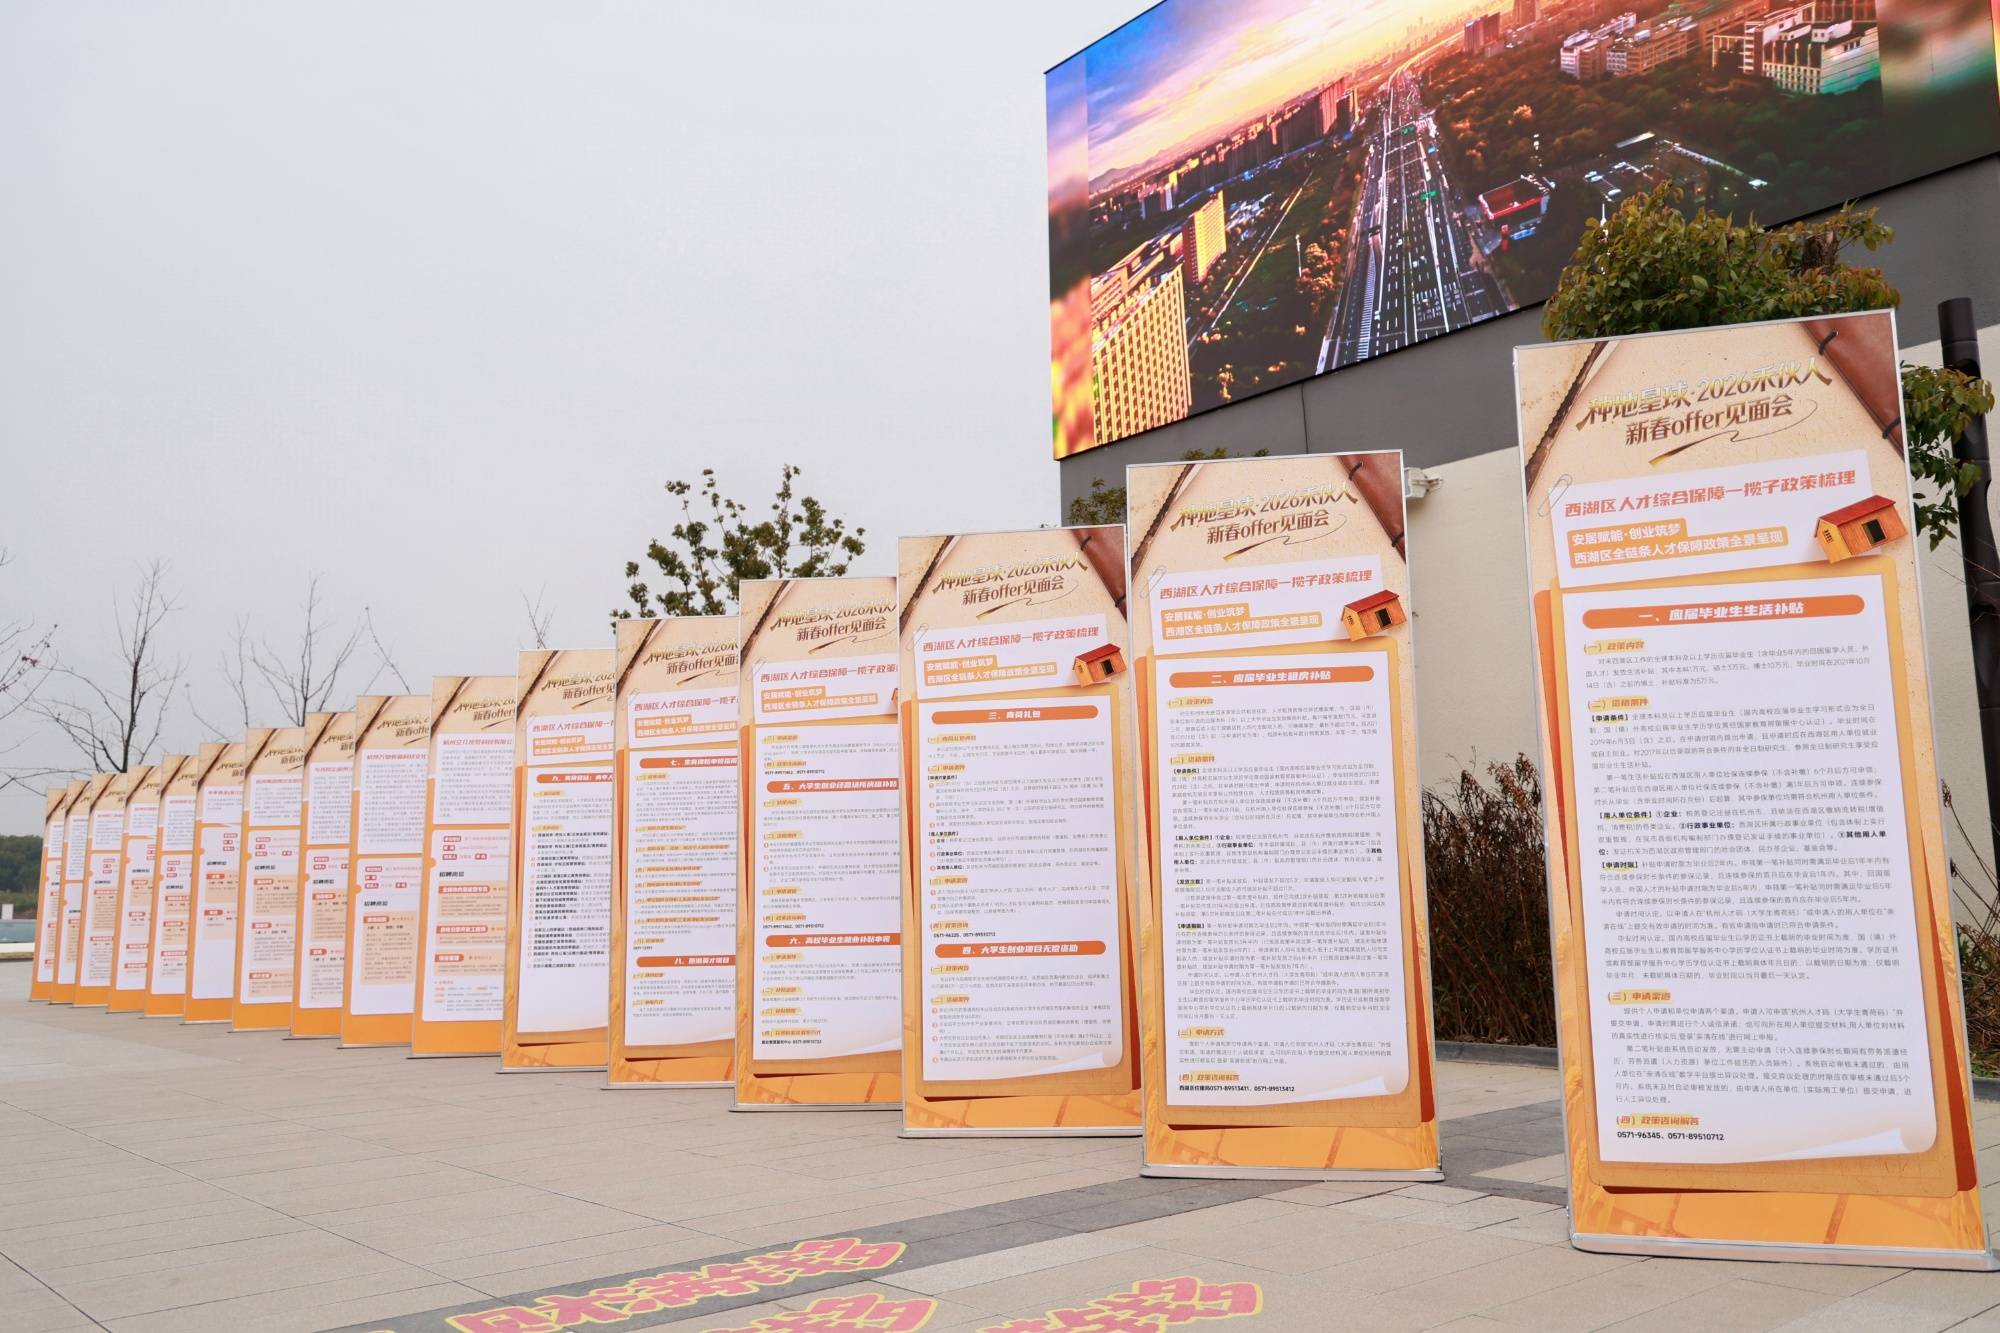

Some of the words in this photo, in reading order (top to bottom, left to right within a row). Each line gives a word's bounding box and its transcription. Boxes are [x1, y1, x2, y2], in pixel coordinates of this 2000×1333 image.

[1576, 357, 1832, 431] 种地星球·2026禾伙人
[1626, 394, 1794, 446] 新春offer见面会
[1564, 470, 1857, 518] 西湖区人才综合保障一揽子政策梳理
[1207, 509, 1330, 545] 新春offer见面会
[1572, 523, 1681, 547] 安居赋能·创业筑梦
[1573, 530, 1785, 566] 西湖区全链条人才保障政策全景呈现
[962, 576, 1065, 606] 新春offer见面会
[1160, 569, 1373, 600] 西湖区人才综合保障一揽子政策梳理
[1638, 603, 1805, 623] 一、应届毕业生生活补贴
[922, 626, 1100, 652] 西湖区人才综合保障一揽子政策梳理
[760, 663, 898, 683] 西湖区人才综合保障一揽子政策
[1211, 669, 1332, 686] 二、应届毕业生租房补贴
[1616, 1129, 1725, 1141] 0571-96345、0571-89510712
